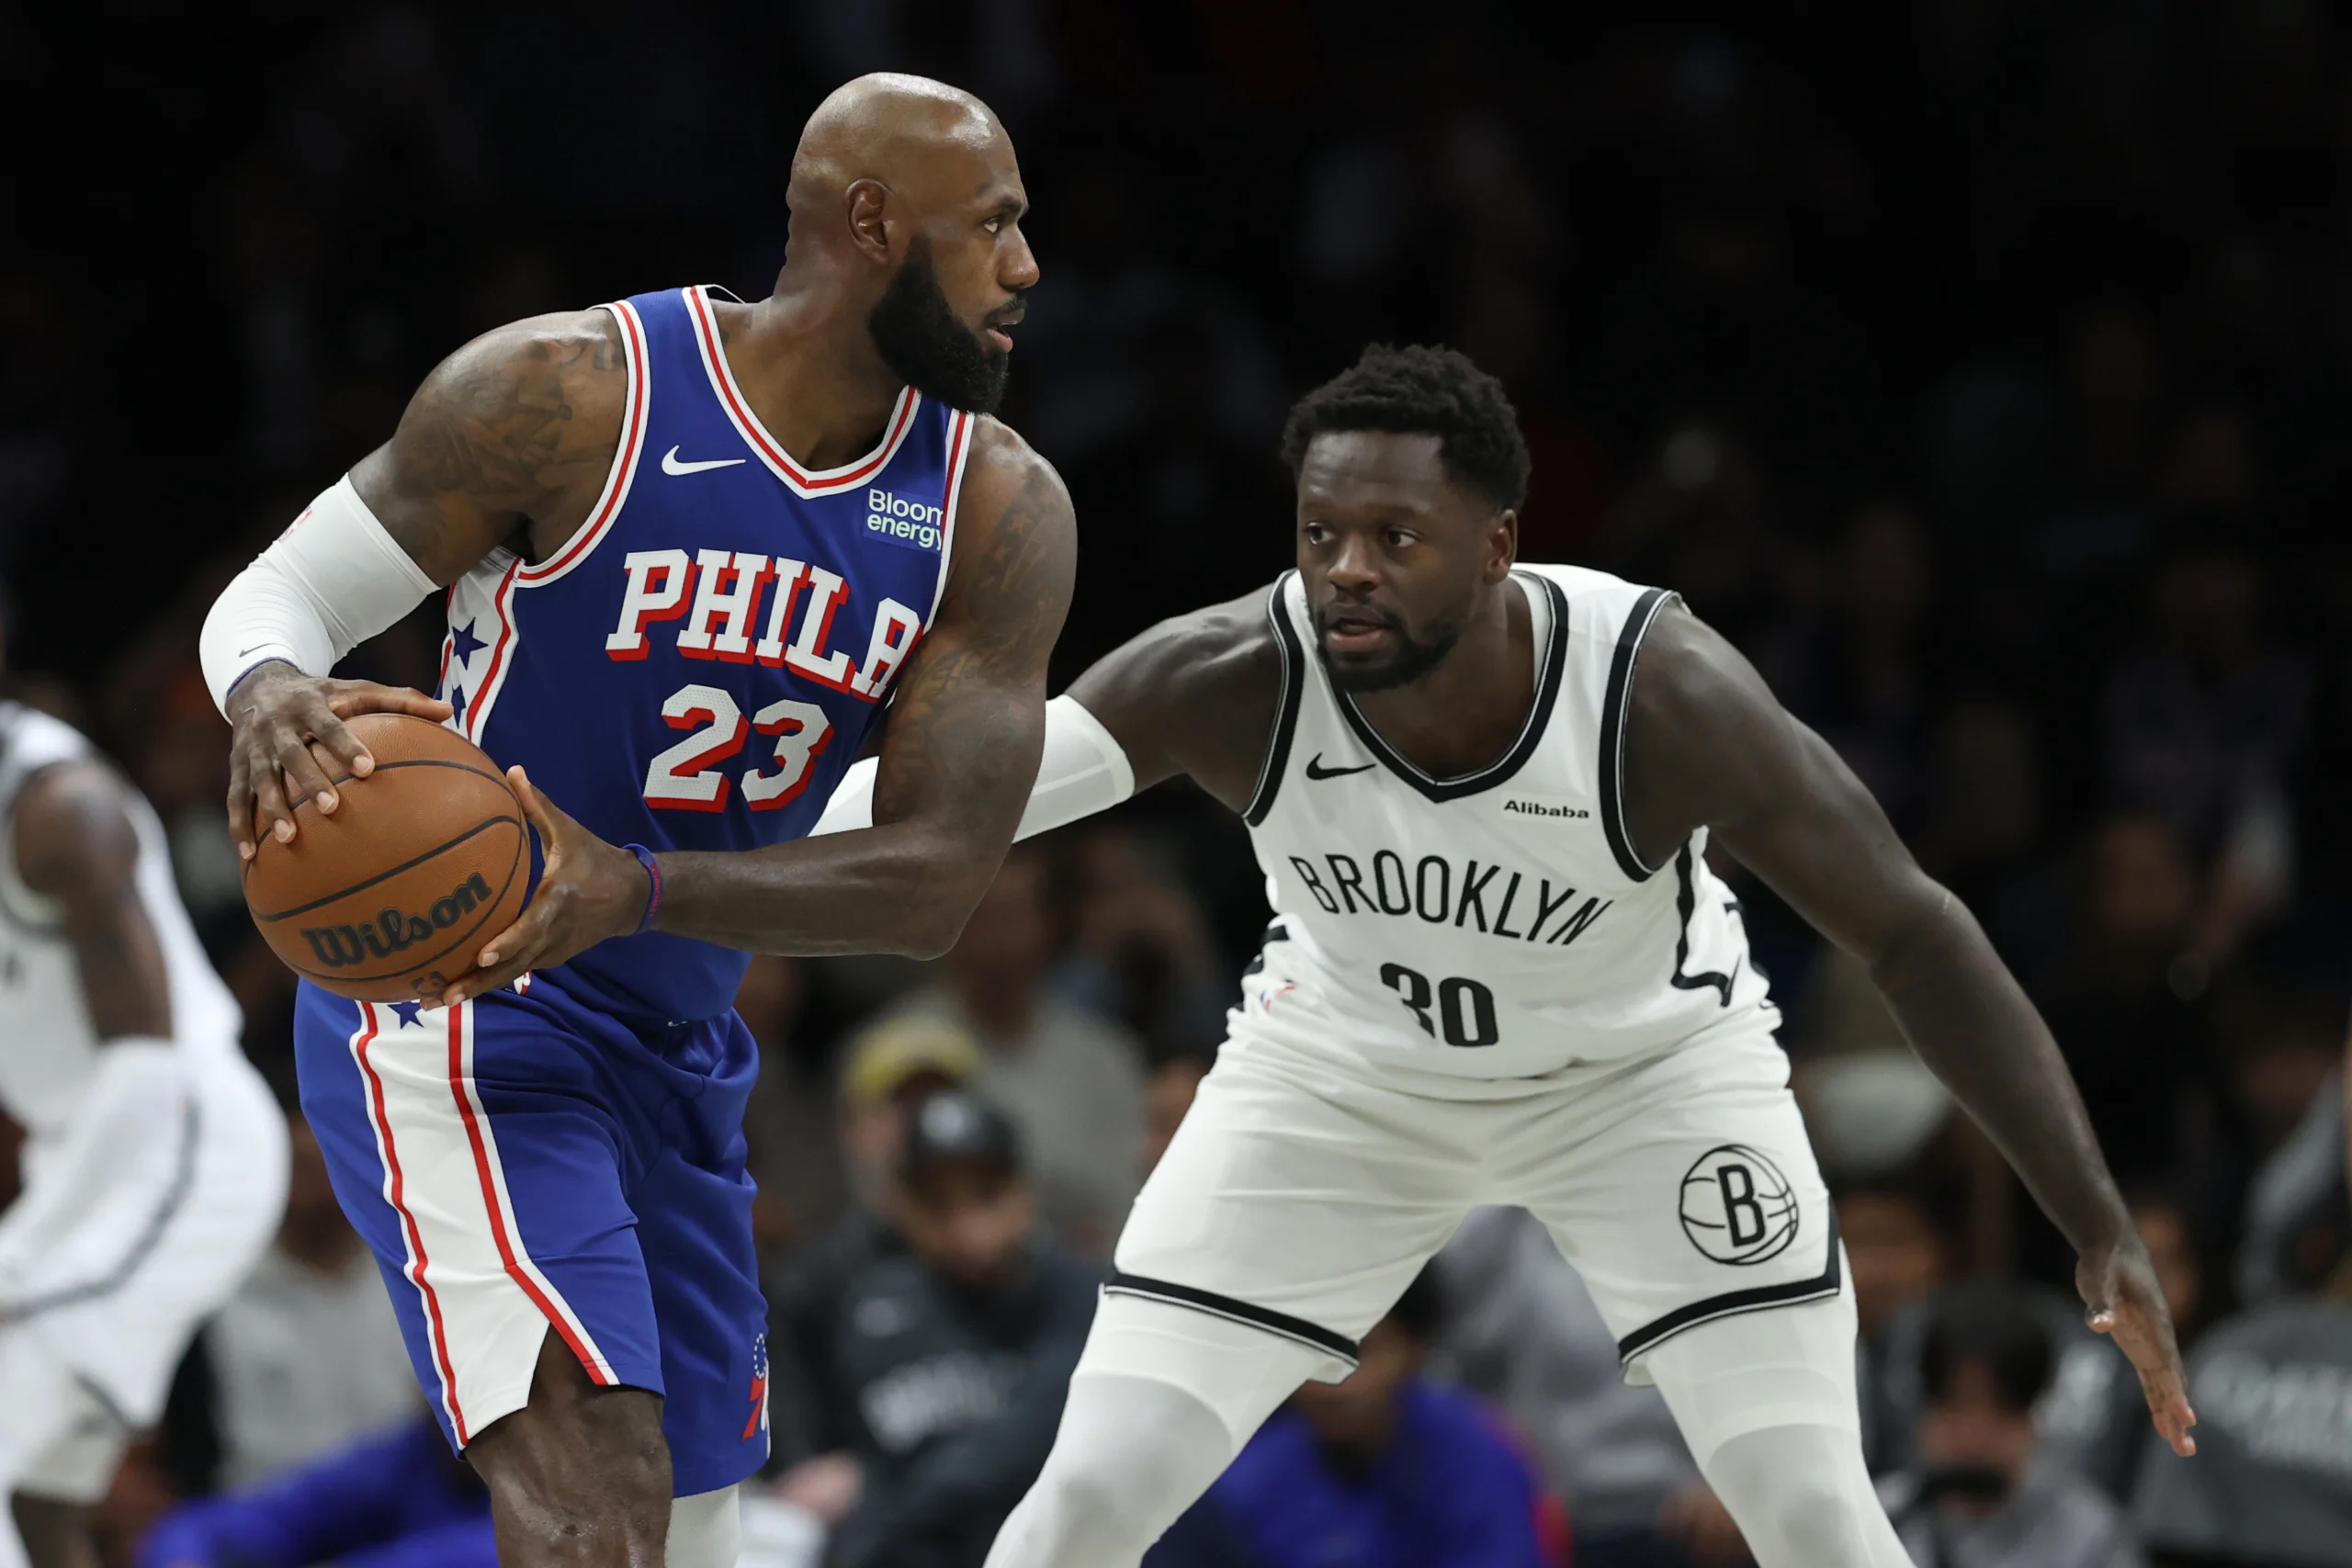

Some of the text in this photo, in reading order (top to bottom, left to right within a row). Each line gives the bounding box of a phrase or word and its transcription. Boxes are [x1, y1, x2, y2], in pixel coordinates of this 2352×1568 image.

[605, 548, 924, 704] PHILA
[642, 683, 835, 813] 23
[1503, 798, 1590, 819] Alibaba
[300, 872, 493, 968] Wilson
[1288, 849, 1614, 946] BROOKLYN
[1715, 1163, 1768, 1248] B
